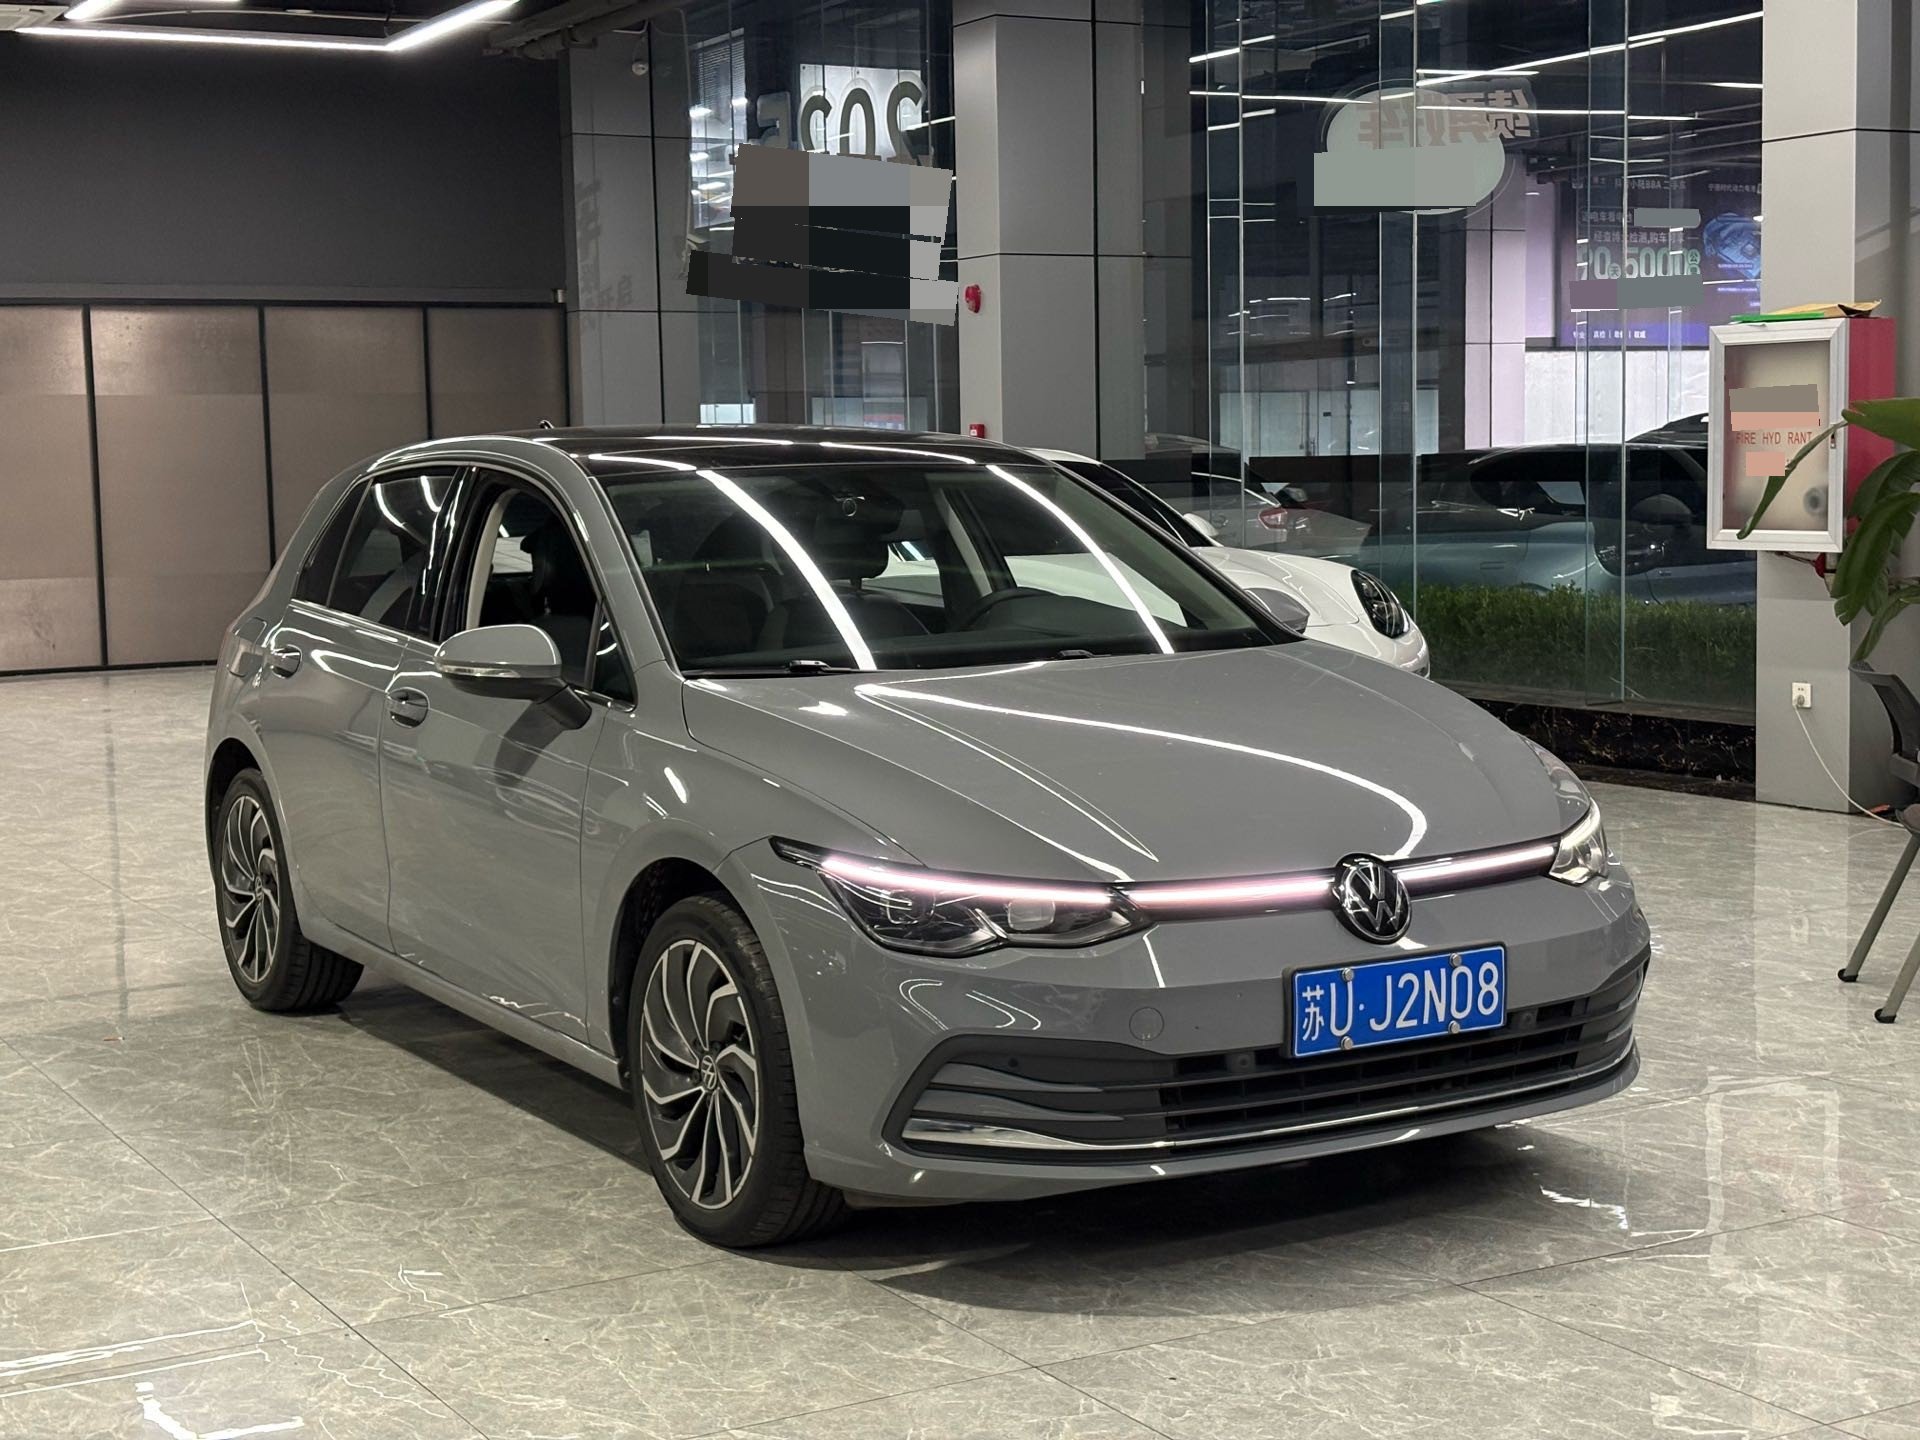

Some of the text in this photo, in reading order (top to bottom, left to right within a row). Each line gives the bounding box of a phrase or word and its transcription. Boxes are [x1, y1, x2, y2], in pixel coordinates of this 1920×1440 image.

[1736, 431, 1812, 445] FIRE HYD RANT
[1302, 961, 1499, 1041] 苏U·J2N08
